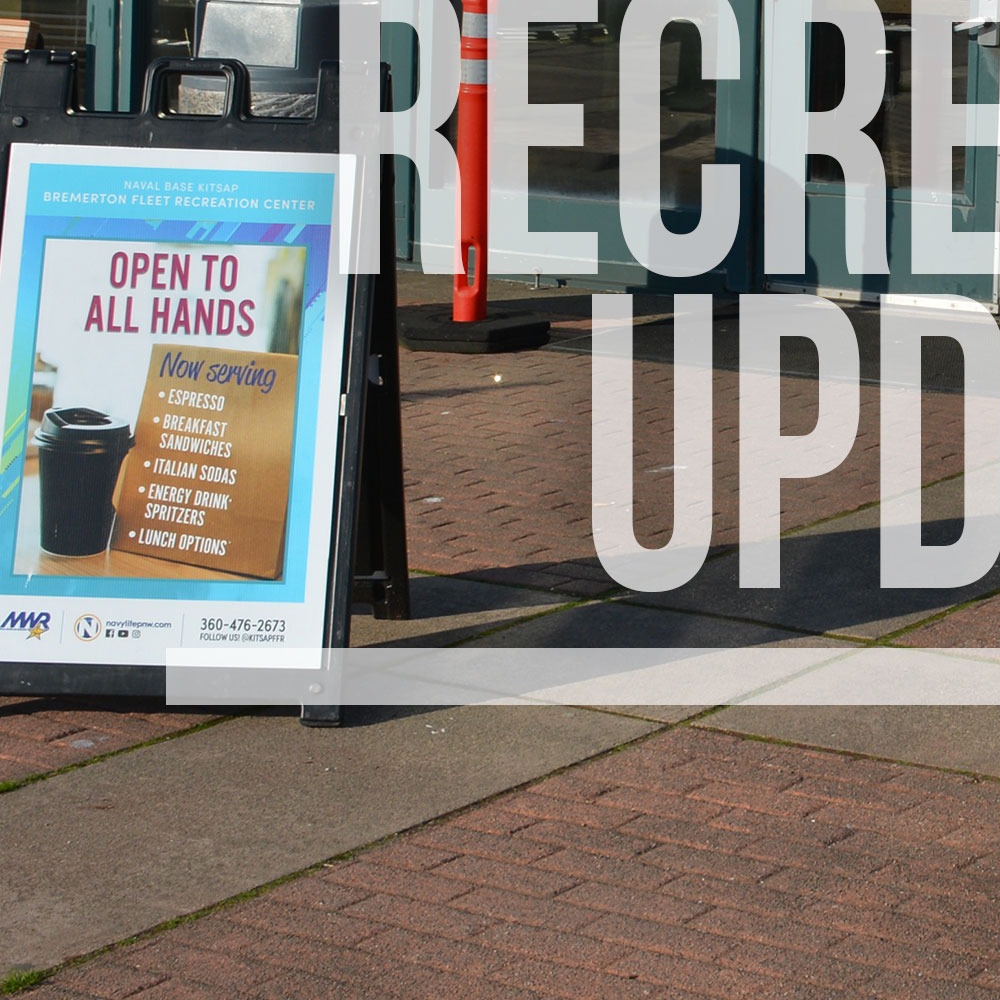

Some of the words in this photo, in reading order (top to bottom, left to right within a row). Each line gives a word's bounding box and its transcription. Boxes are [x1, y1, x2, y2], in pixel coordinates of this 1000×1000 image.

[123, 180, 160, 191] NAVAL
[164, 182, 193, 192] BASE
[198, 183, 239, 193] KITSAP
[43, 191, 127, 205] BREMERTON
[132, 194, 169, 206] FLEET
[175, 195, 259, 209] RECREATION
[264, 198, 316, 211] CENTER
[110, 251, 190, 290] OPEN
[202, 254, 239, 292] TO
[84, 295, 139, 333] ALL
[151, 297, 255, 337] HANDS
[159, 352, 205, 381] Now
[206, 360, 277, 394] serving
[168, 389, 225, 411] ESPRESSO
[163, 413, 228, 438] BREAKFAST
[159, 433, 232, 458] SANDWICHES
[153, 458, 197, 479] ITALIAN
[200, 465, 237, 485] SODAS
[148, 483, 192, 505] ENERGY
[144, 503, 206, 526] SPRITZERS
[138, 528, 176, 548] LUNCH
[1, 611, 51, 629] MWR
[106, 619, 172, 630] navylifepnw.com
[200, 617, 286, 632] 360-476-2673
[200, 632, 228, 641] FOLLOW
[241, 633, 285, 643] @KITSAPFFR
